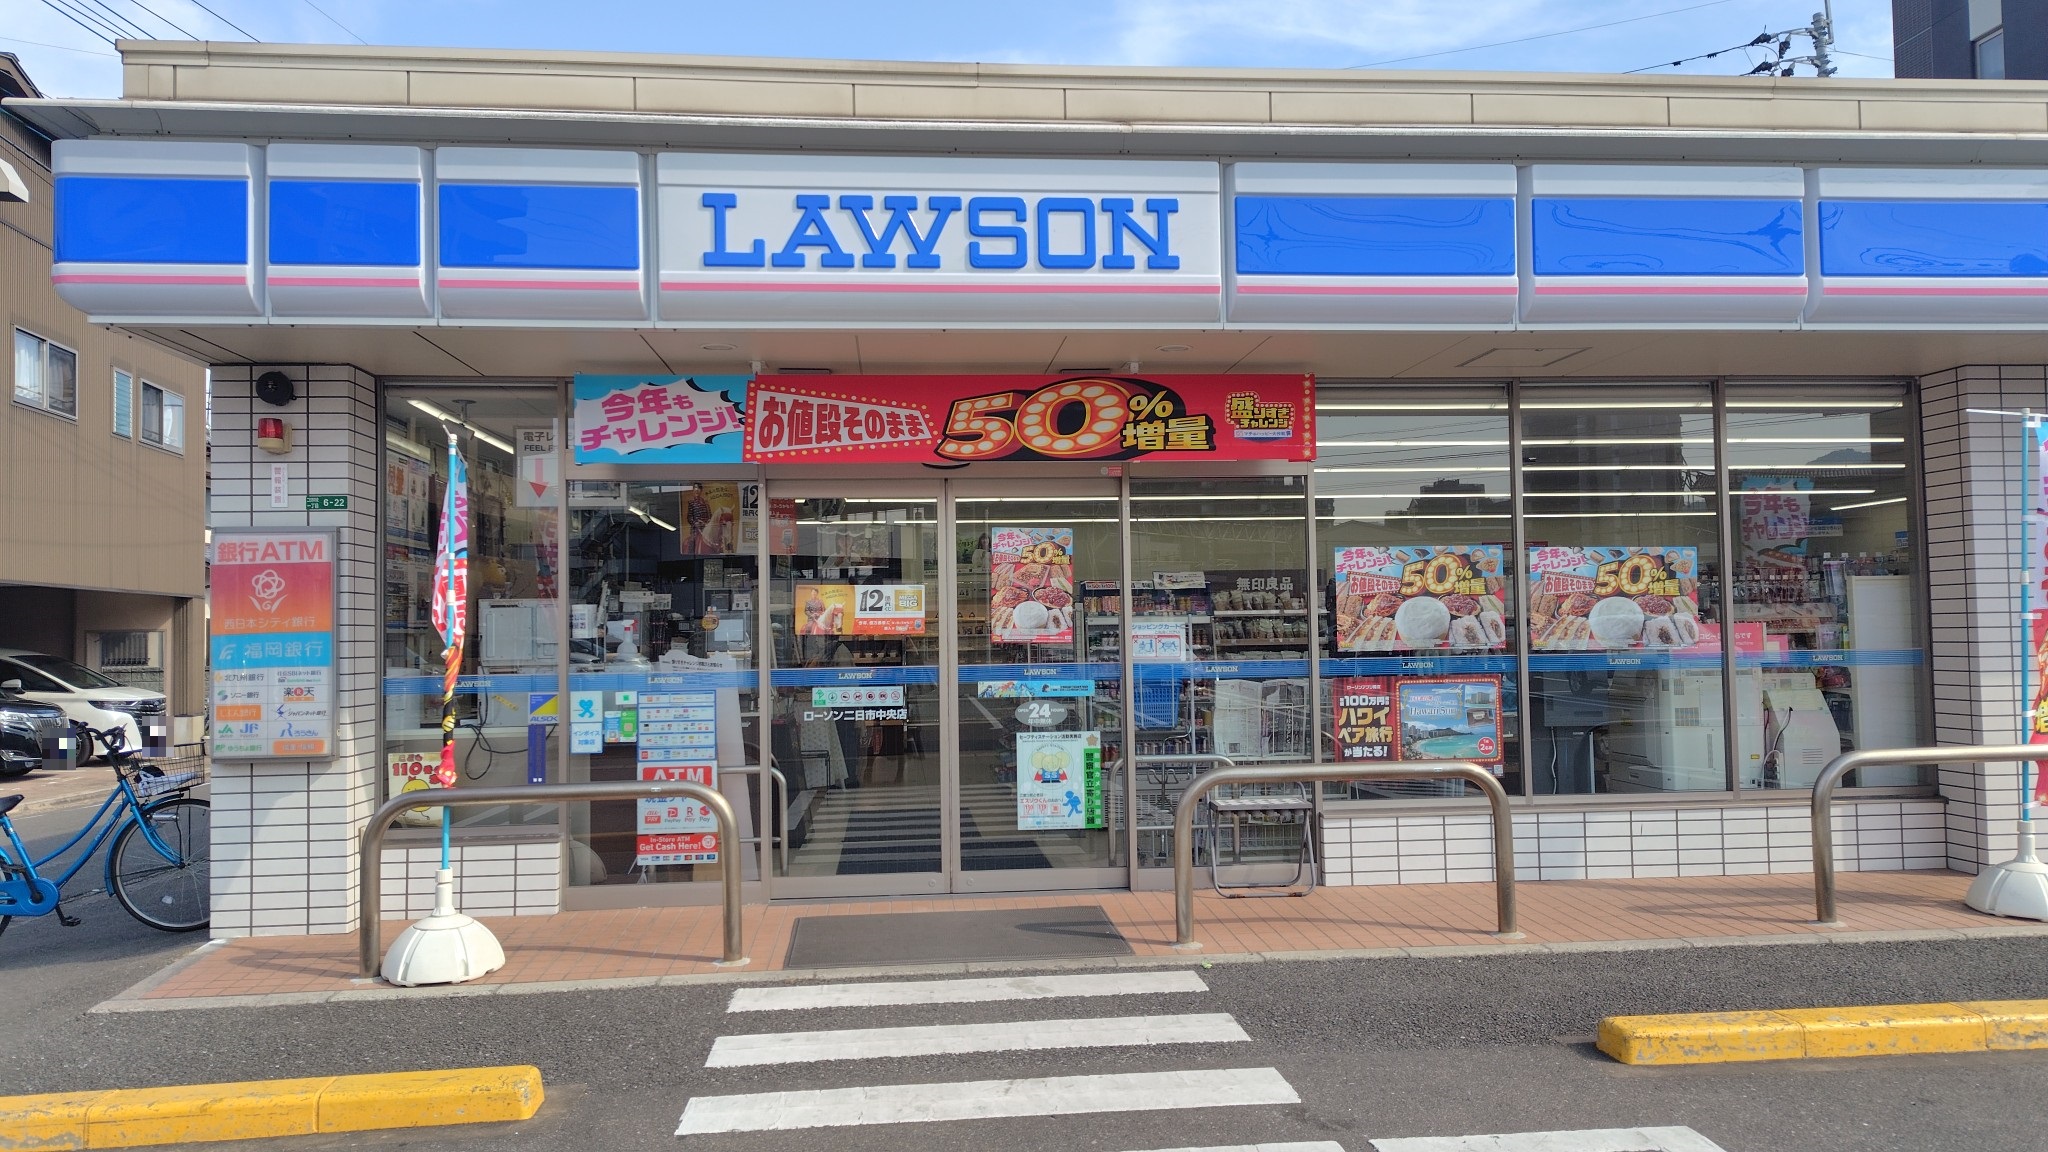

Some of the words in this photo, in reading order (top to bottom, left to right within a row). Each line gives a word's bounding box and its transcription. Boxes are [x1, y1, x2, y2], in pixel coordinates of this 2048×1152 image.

[702, 192, 1180, 270] LAWSON
[601, 387, 694, 423] 今年も
[1230, 397, 1290, 419] 盛りすぎ
[580, 406, 742, 450] チャレンジ!
[758, 396, 925, 449] お値段そのまま
[1240, 418, 1288, 429] チャレンジ
[1121, 415, 1211, 452] 増量
[524, 444, 546, 452] FEEL
[323, 498, 345, 507] 6-22
[218, 541, 323, 562] 銀行ATM
[1342, 548, 1375, 563] 今年も
[1536, 548, 1569, 562] 今年も
[1336, 556, 1393, 573] チャレンジ!
[1531, 555, 1588, 572] チャレンジ!
[1236, 576, 1295, 591] 無印良品
[1350, 576, 1400, 593] お値段そのまま
[1545, 576, 1595, 593] お値段そのまま
[859, 589, 884, 612] 12
[224, 616, 316, 630] 西日本シティ銀行
[246, 641, 323, 659] 福岡銀行
[1402, 661, 1434, 669] LAWSON
[1811, 654, 1844, 662] LAWSON
[838, 672, 873, 680] LAWSON
[1023, 668, 1057, 676] LAWSON
[1205, 665, 1239, 673] LAWSON
[224, 673, 264, 682] 北九州銀行
[454, 680, 492, 688] LAWSON
[648, 676, 683, 684] LAWSON
[230, 691, 260, 699] ソニー銀行
[804, 709, 908, 721] ローソン二日市中央店
[1028, 703, 1051, 718] 24
[1338, 707, 1390, 726] ハワイ
[218, 724, 234, 734] JA
[240, 723, 259, 734] JF
[293, 729, 319, 737] ろうきん
[573, 730, 602, 738] インボイス
[1338, 727, 1394, 744] ペア旅行
[227, 744, 262, 752] ゆうちょ銀行
[1344, 745, 1388, 758] が当たる!
[653, 767, 705, 784] ATM
[640, 843, 654, 851] Get
[656, 843, 677, 851] Cash
